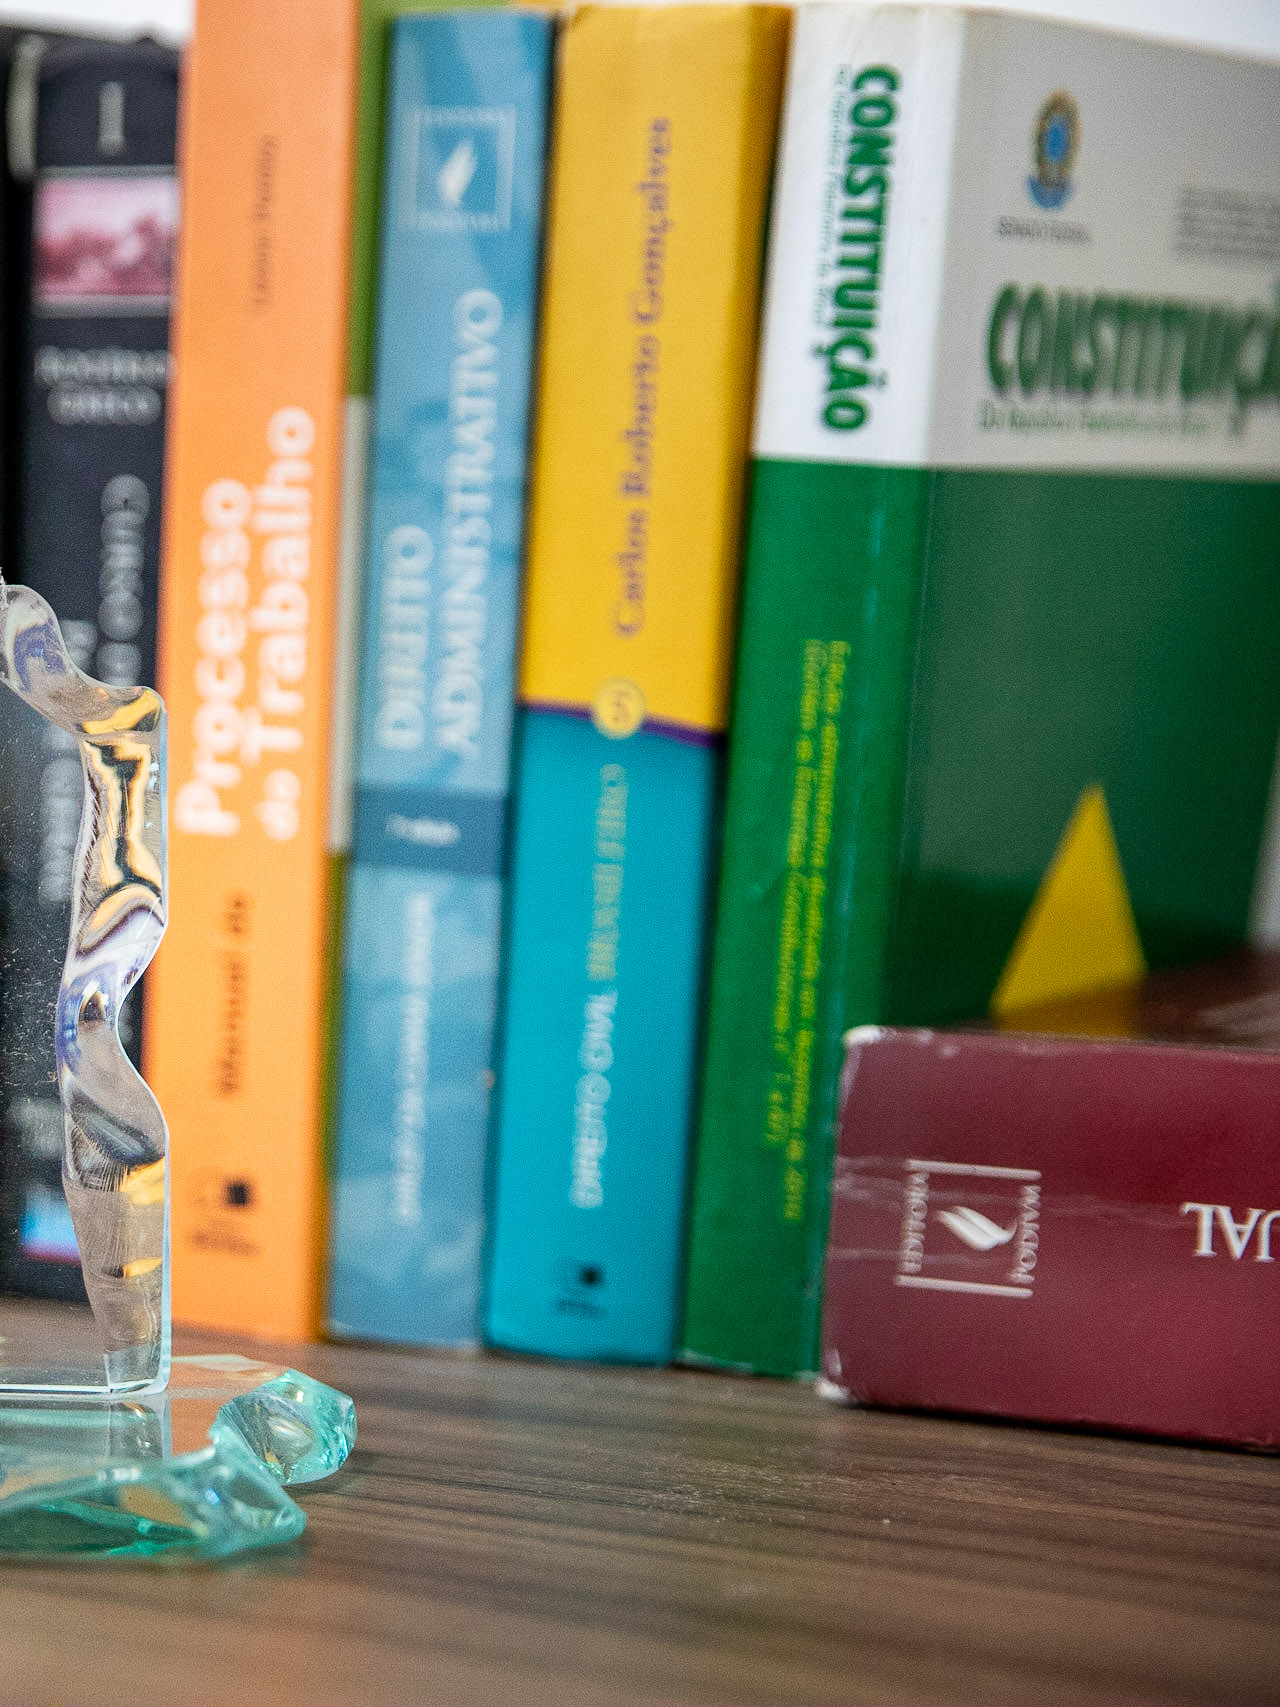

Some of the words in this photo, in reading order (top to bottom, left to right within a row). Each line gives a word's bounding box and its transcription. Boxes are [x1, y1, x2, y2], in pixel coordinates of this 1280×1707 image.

[625, 117, 676, 328] Gonçalves
[811, 63, 902, 433] CONSTITUIÇÃO
[431, 288, 504, 760] ADMINISTRATIVO
[614, 335, 660, 500] Roberto
[174, 477, 254, 838] Processo
[239, 405, 317, 765] Trabalho
[375, 523, 435, 752] DIREITO
[610, 511, 649, 639] Carlos
[254, 768, 302, 841] do
[901, 1171, 929, 1274] EDITORA
